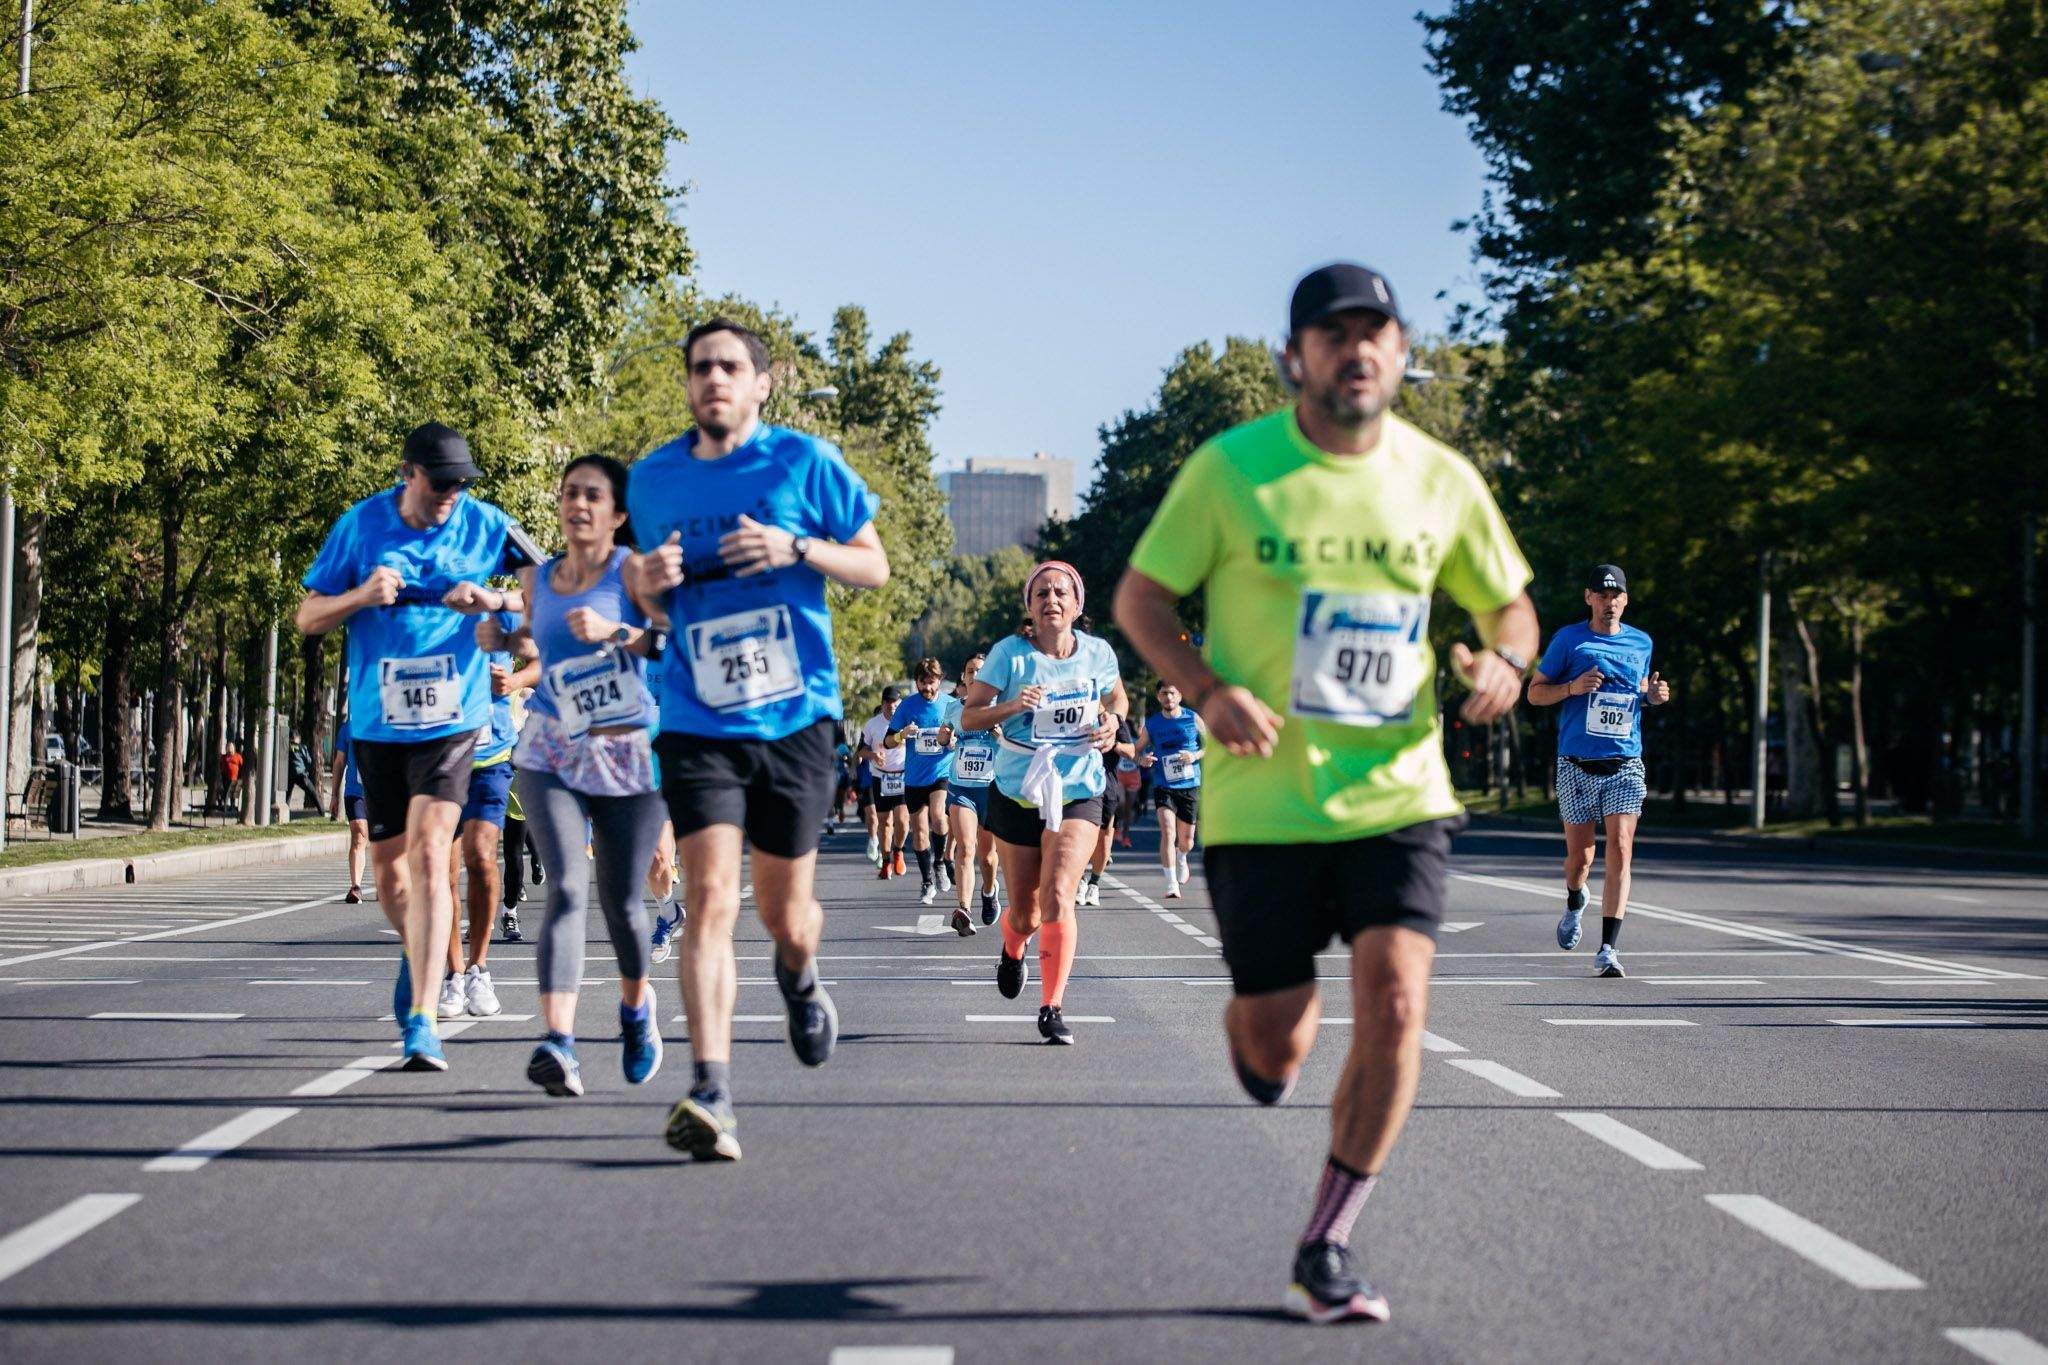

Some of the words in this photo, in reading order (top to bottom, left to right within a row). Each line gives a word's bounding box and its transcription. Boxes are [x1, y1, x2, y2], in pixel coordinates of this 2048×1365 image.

[720, 649, 768, 684] 255
[1336, 648, 1392, 684] 970
[403, 687, 436, 708] 146
[573, 680, 621, 715] 1324
[1054, 706, 1084, 724] 507
[1600, 711, 1623, 725] 302
[963, 761, 985, 772] 1937
